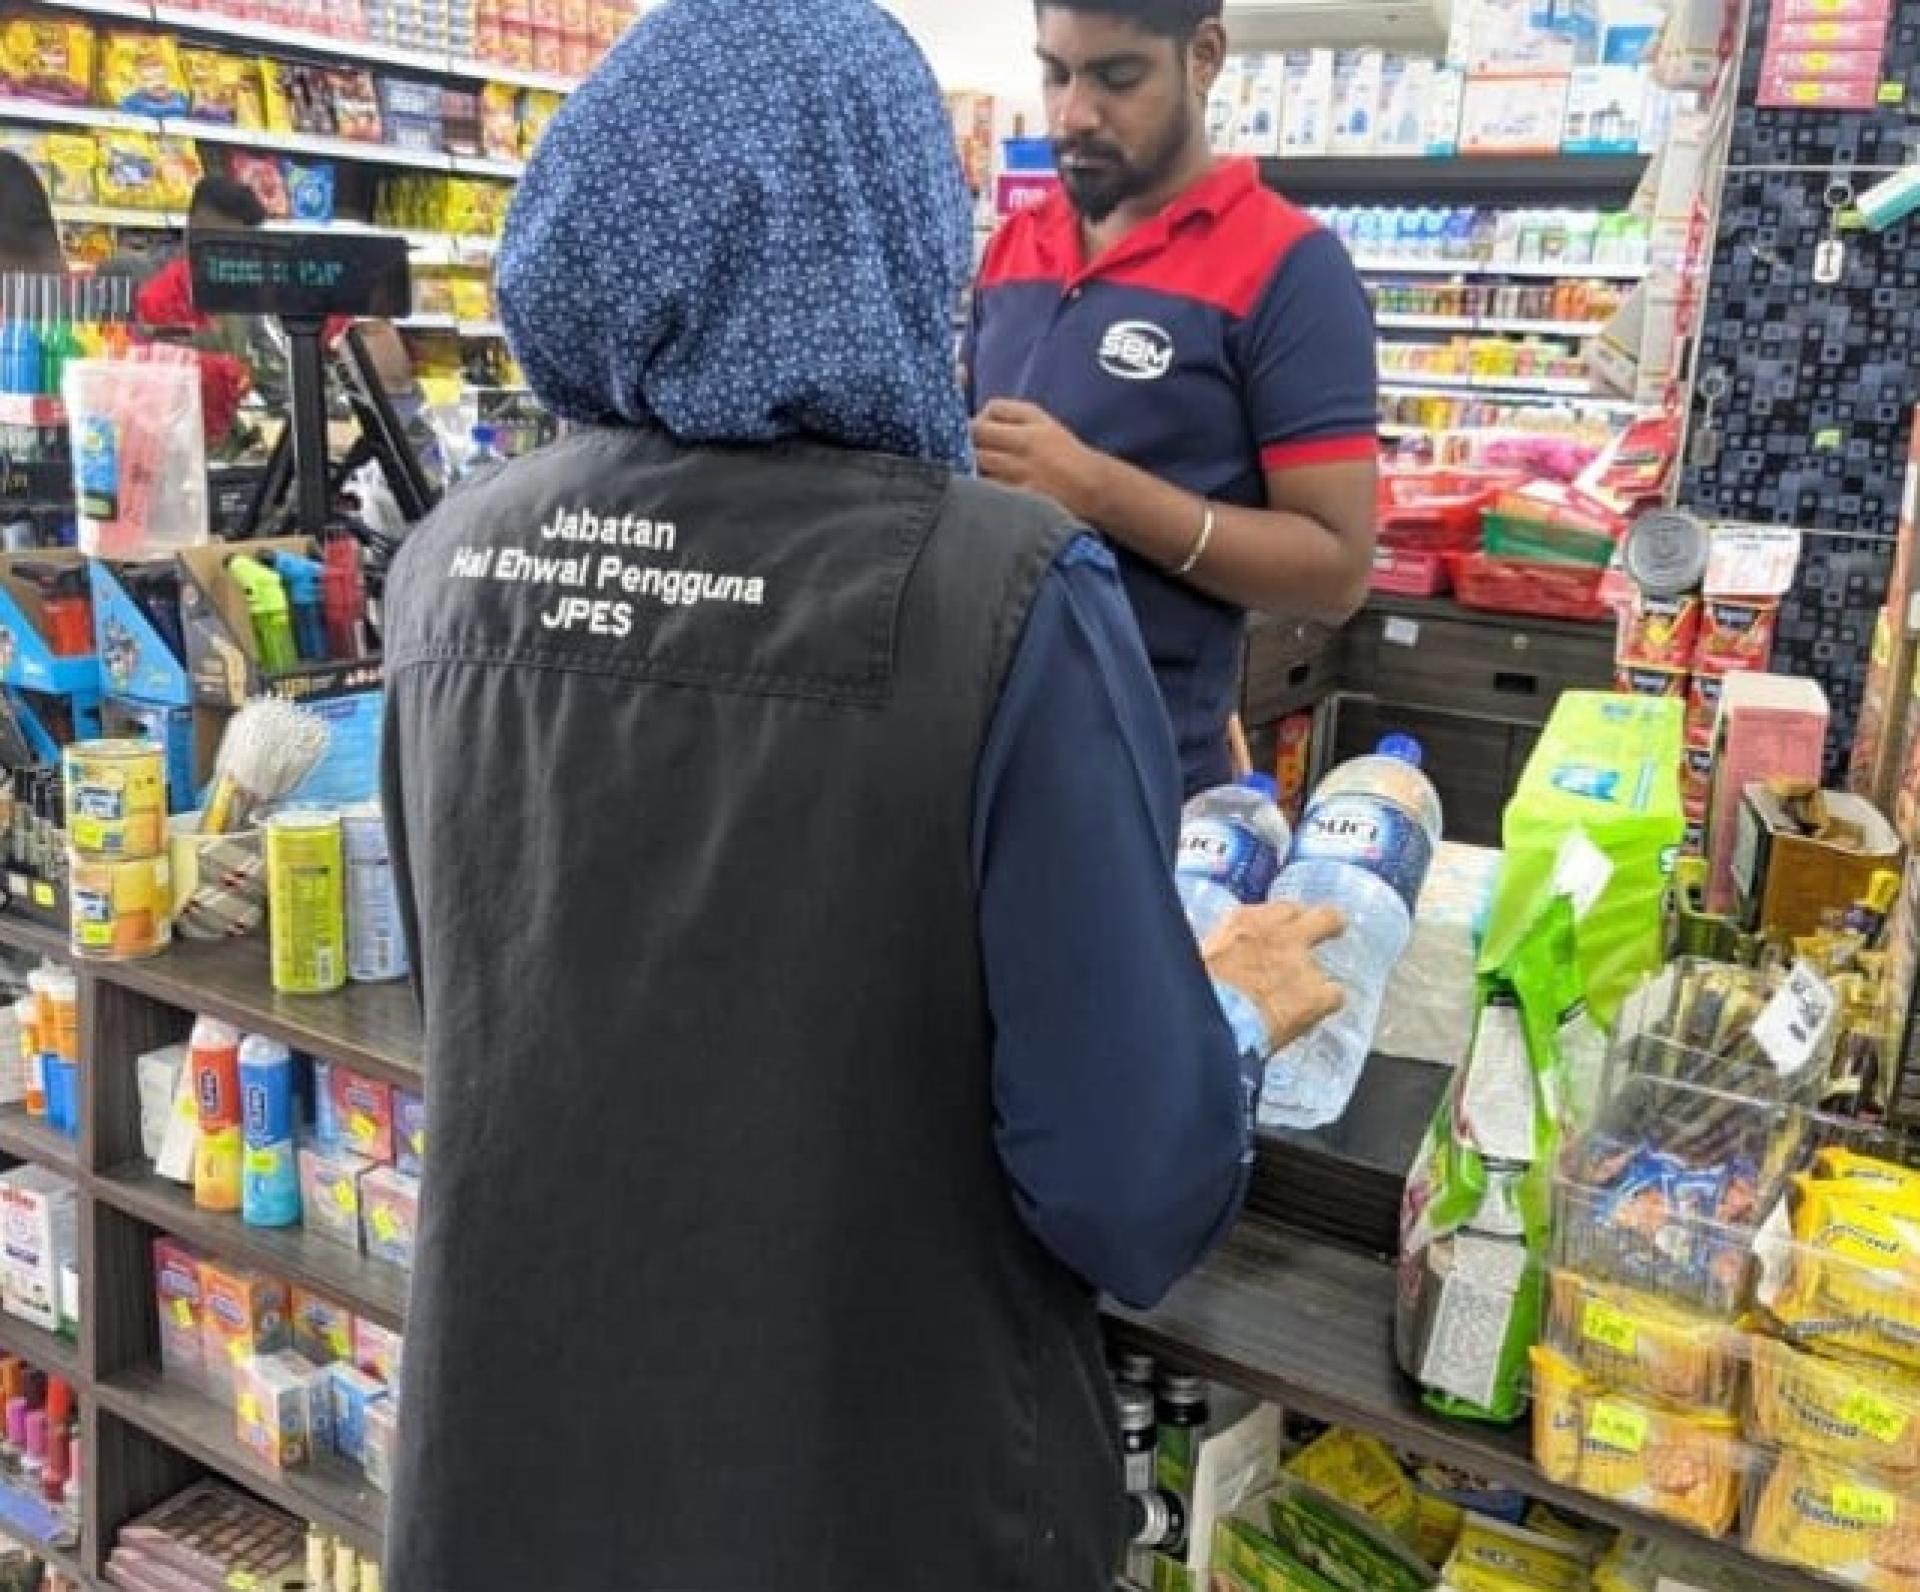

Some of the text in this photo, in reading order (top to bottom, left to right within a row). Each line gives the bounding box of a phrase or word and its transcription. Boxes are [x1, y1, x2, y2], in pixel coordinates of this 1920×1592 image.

[541, 507, 677, 551] Jabatan
[495, 546, 592, 587] Ehwal
[598, 554, 766, 606] Pengguna
[541, 596, 635, 637] JPES
